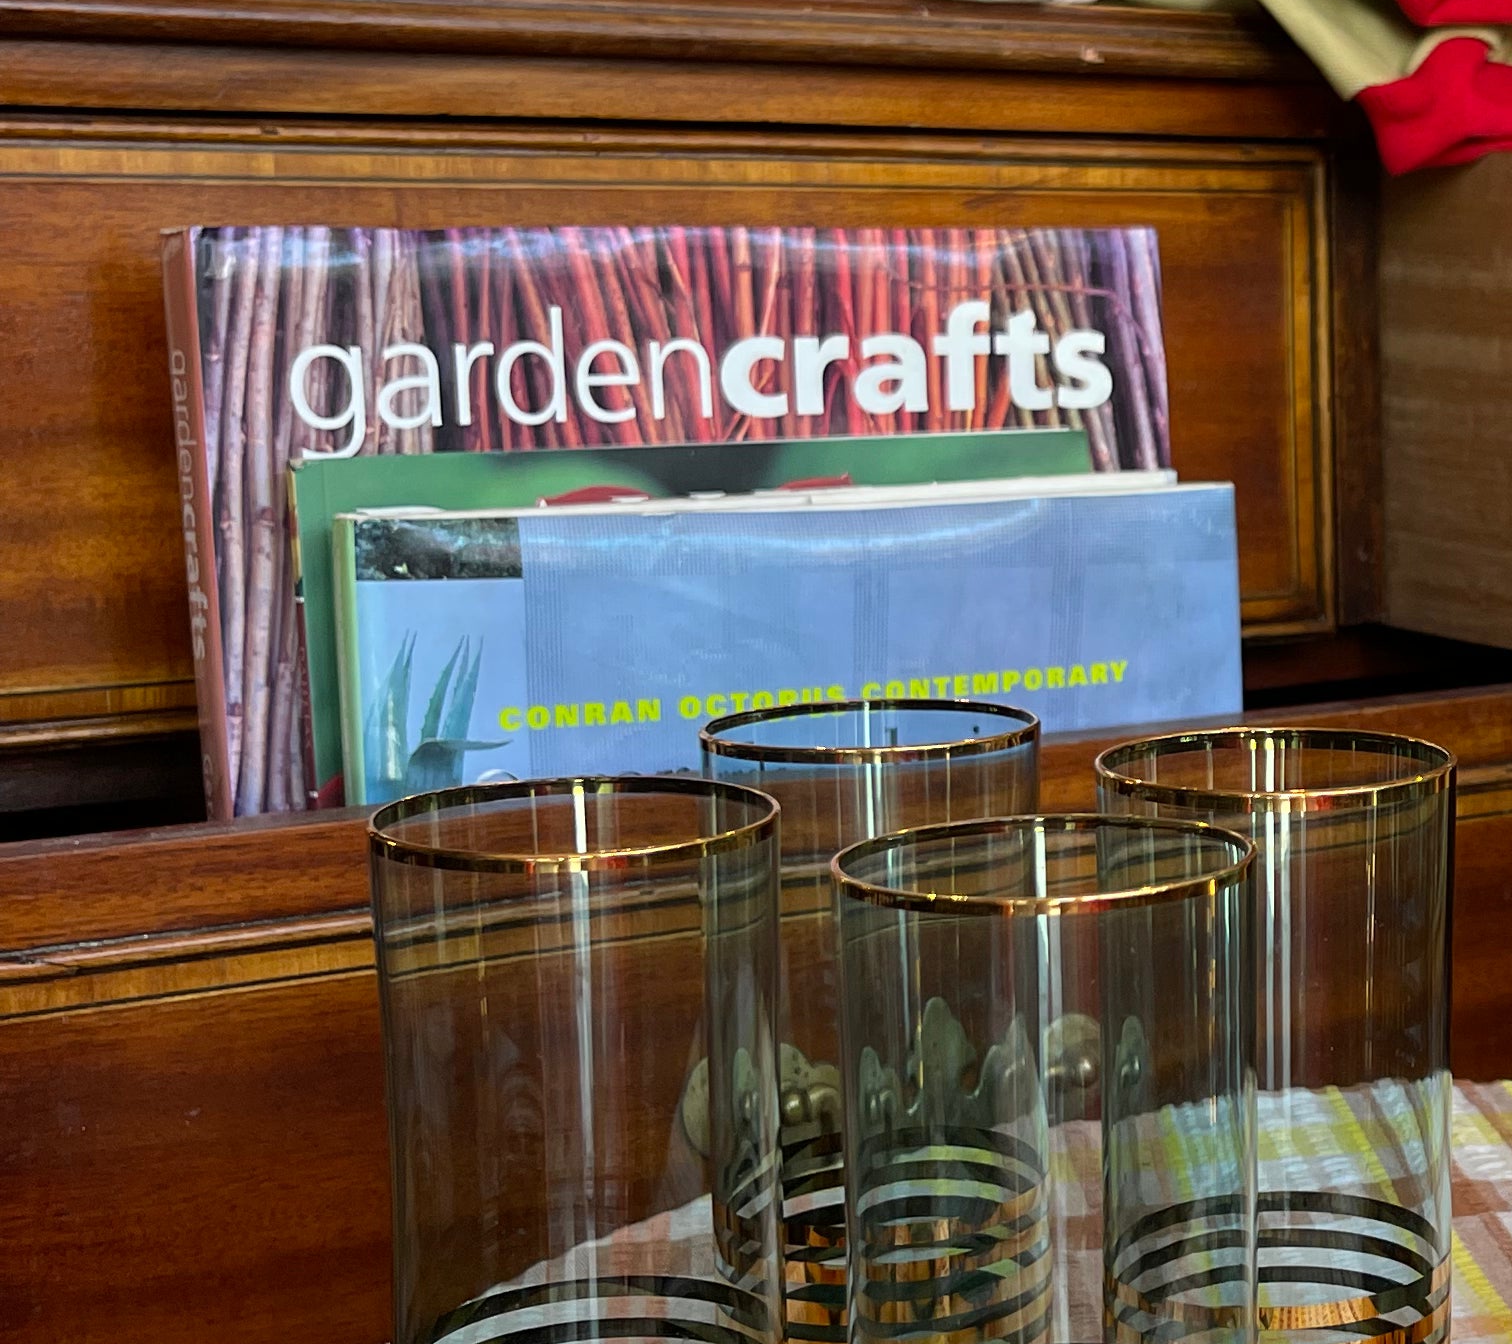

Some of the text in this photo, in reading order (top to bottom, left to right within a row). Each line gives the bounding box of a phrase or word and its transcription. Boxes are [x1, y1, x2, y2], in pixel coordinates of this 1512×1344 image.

[290, 300, 1113, 461] gardencrafts
[498, 698, 662, 732] CONRAN
[862, 659, 1128, 701] CONTEMPORARY
